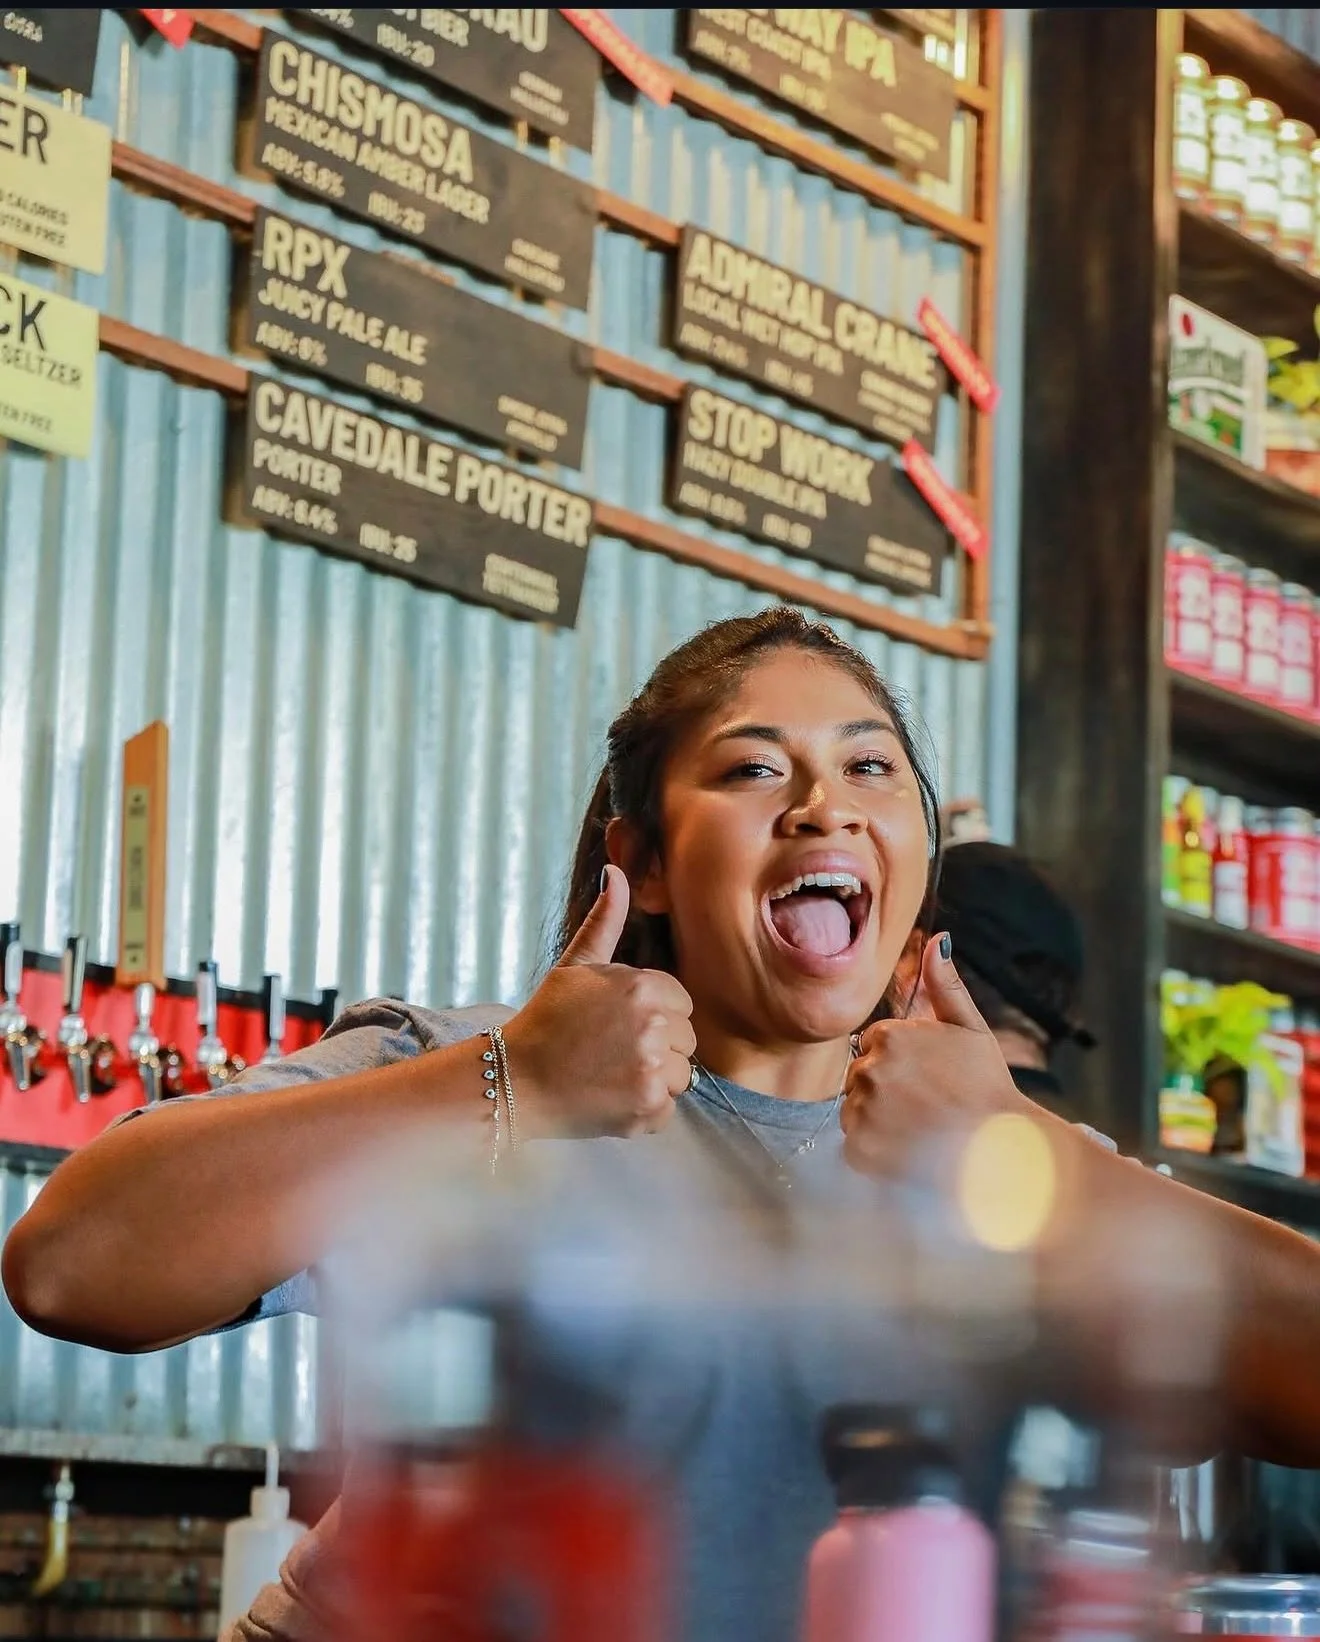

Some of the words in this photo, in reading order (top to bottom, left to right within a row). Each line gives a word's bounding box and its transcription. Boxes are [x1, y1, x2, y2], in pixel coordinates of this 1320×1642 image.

[845, 20, 897, 88] IPA
[265, 96, 357, 162] MEXICAN
[356, 141, 426, 195] AMBER
[425, 172, 490, 225] LAGER
[268, 41, 473, 183] CHISMOSA
[263, 215, 351, 298] RPX
[258, 277, 327, 324] JUICY
[326, 301, 385, 349] PALE
[383, 325, 428, 366] ALE
[686, 232, 832, 340] ADMIRAL
[833, 302, 938, 390] CRANE
[2, 343, 83, 390] SELTZER
[253, 438, 343, 496] PORTER
[255, 382, 454, 496] CAVEDALE
[455, 453, 593, 547] PORTER
[687, 389, 778, 463] STOP
[779, 425, 875, 507] WORK
